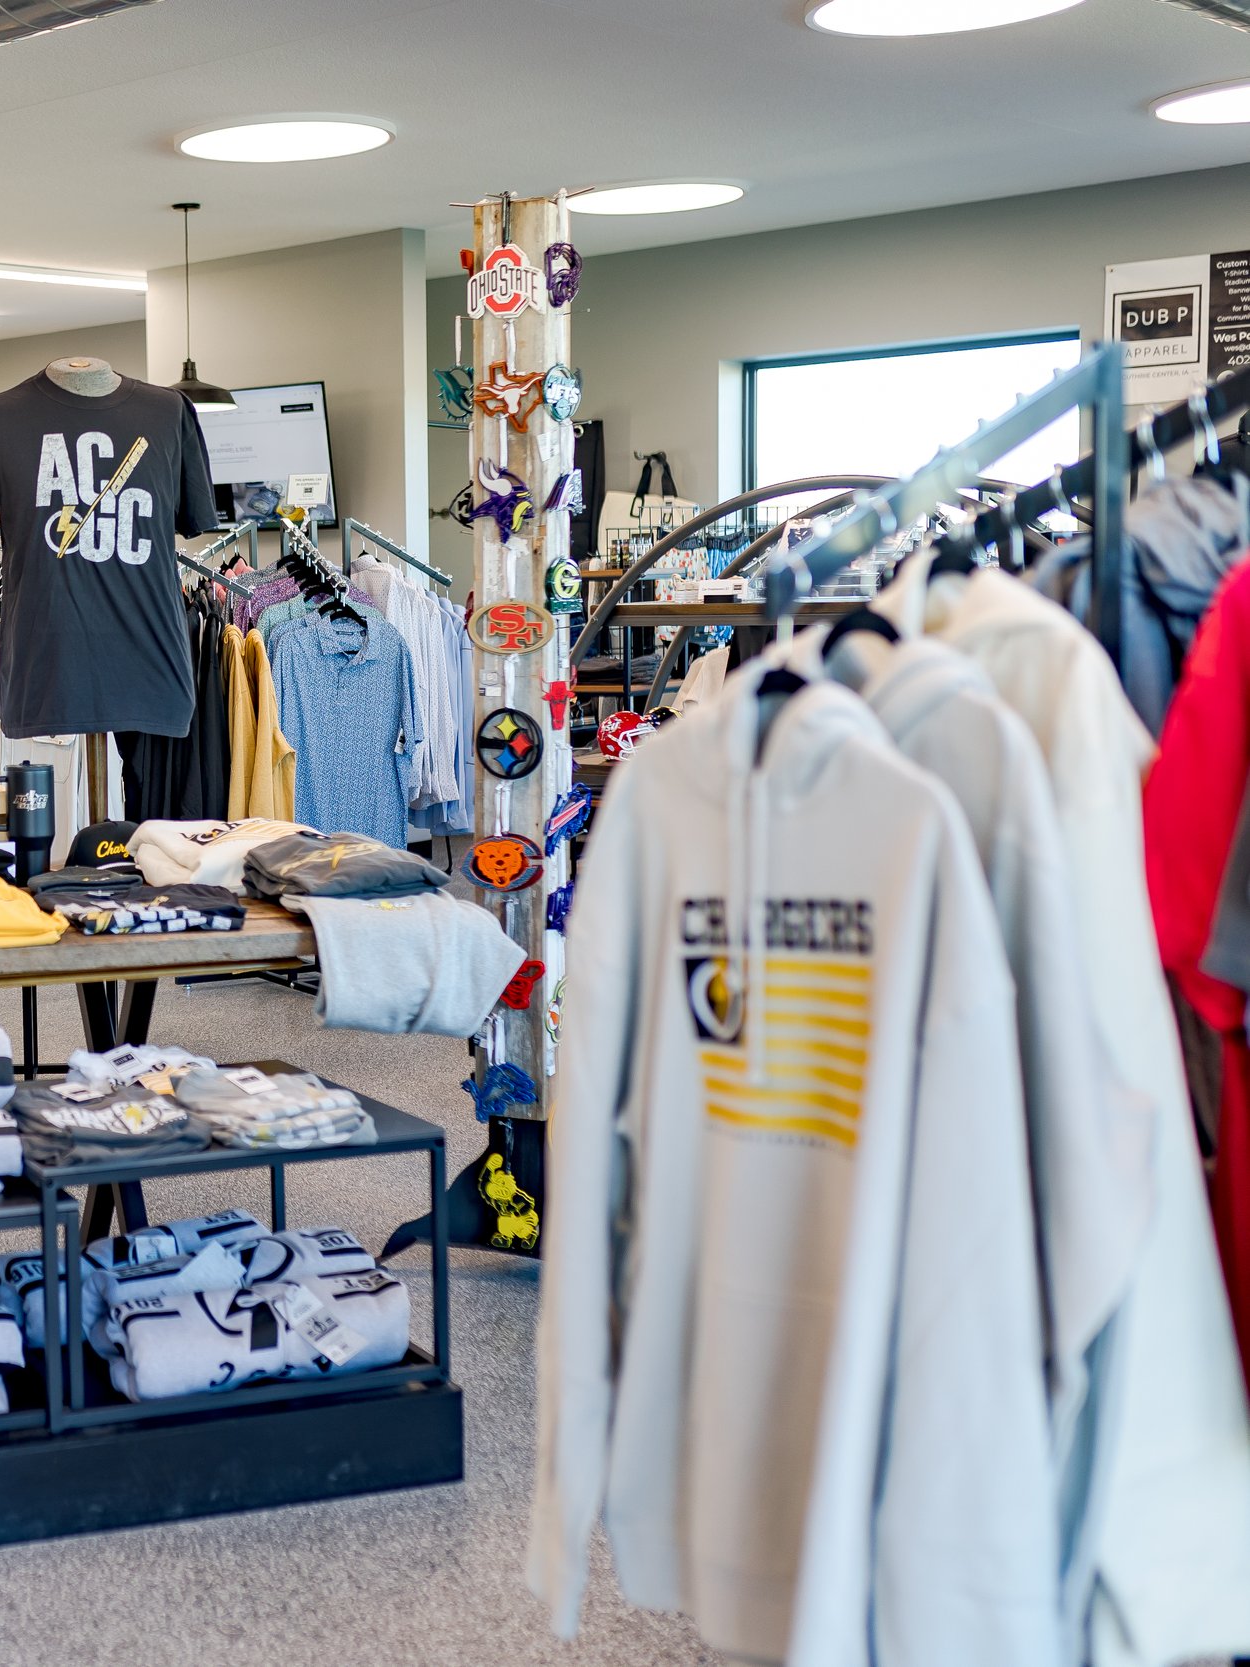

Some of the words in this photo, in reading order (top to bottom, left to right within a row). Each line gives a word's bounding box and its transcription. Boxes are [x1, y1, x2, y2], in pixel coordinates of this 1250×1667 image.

[1216, 260, 1248, 269] Custom
[1126, 308, 1169, 327] DUB
[1177, 306, 1188, 322] P
[1213, 333, 1237, 343] Wes
[1125, 344, 1188, 358] APPAREL
[1228, 354, 1250, 366] 402
[683, 897, 872, 954] CHRGERS
